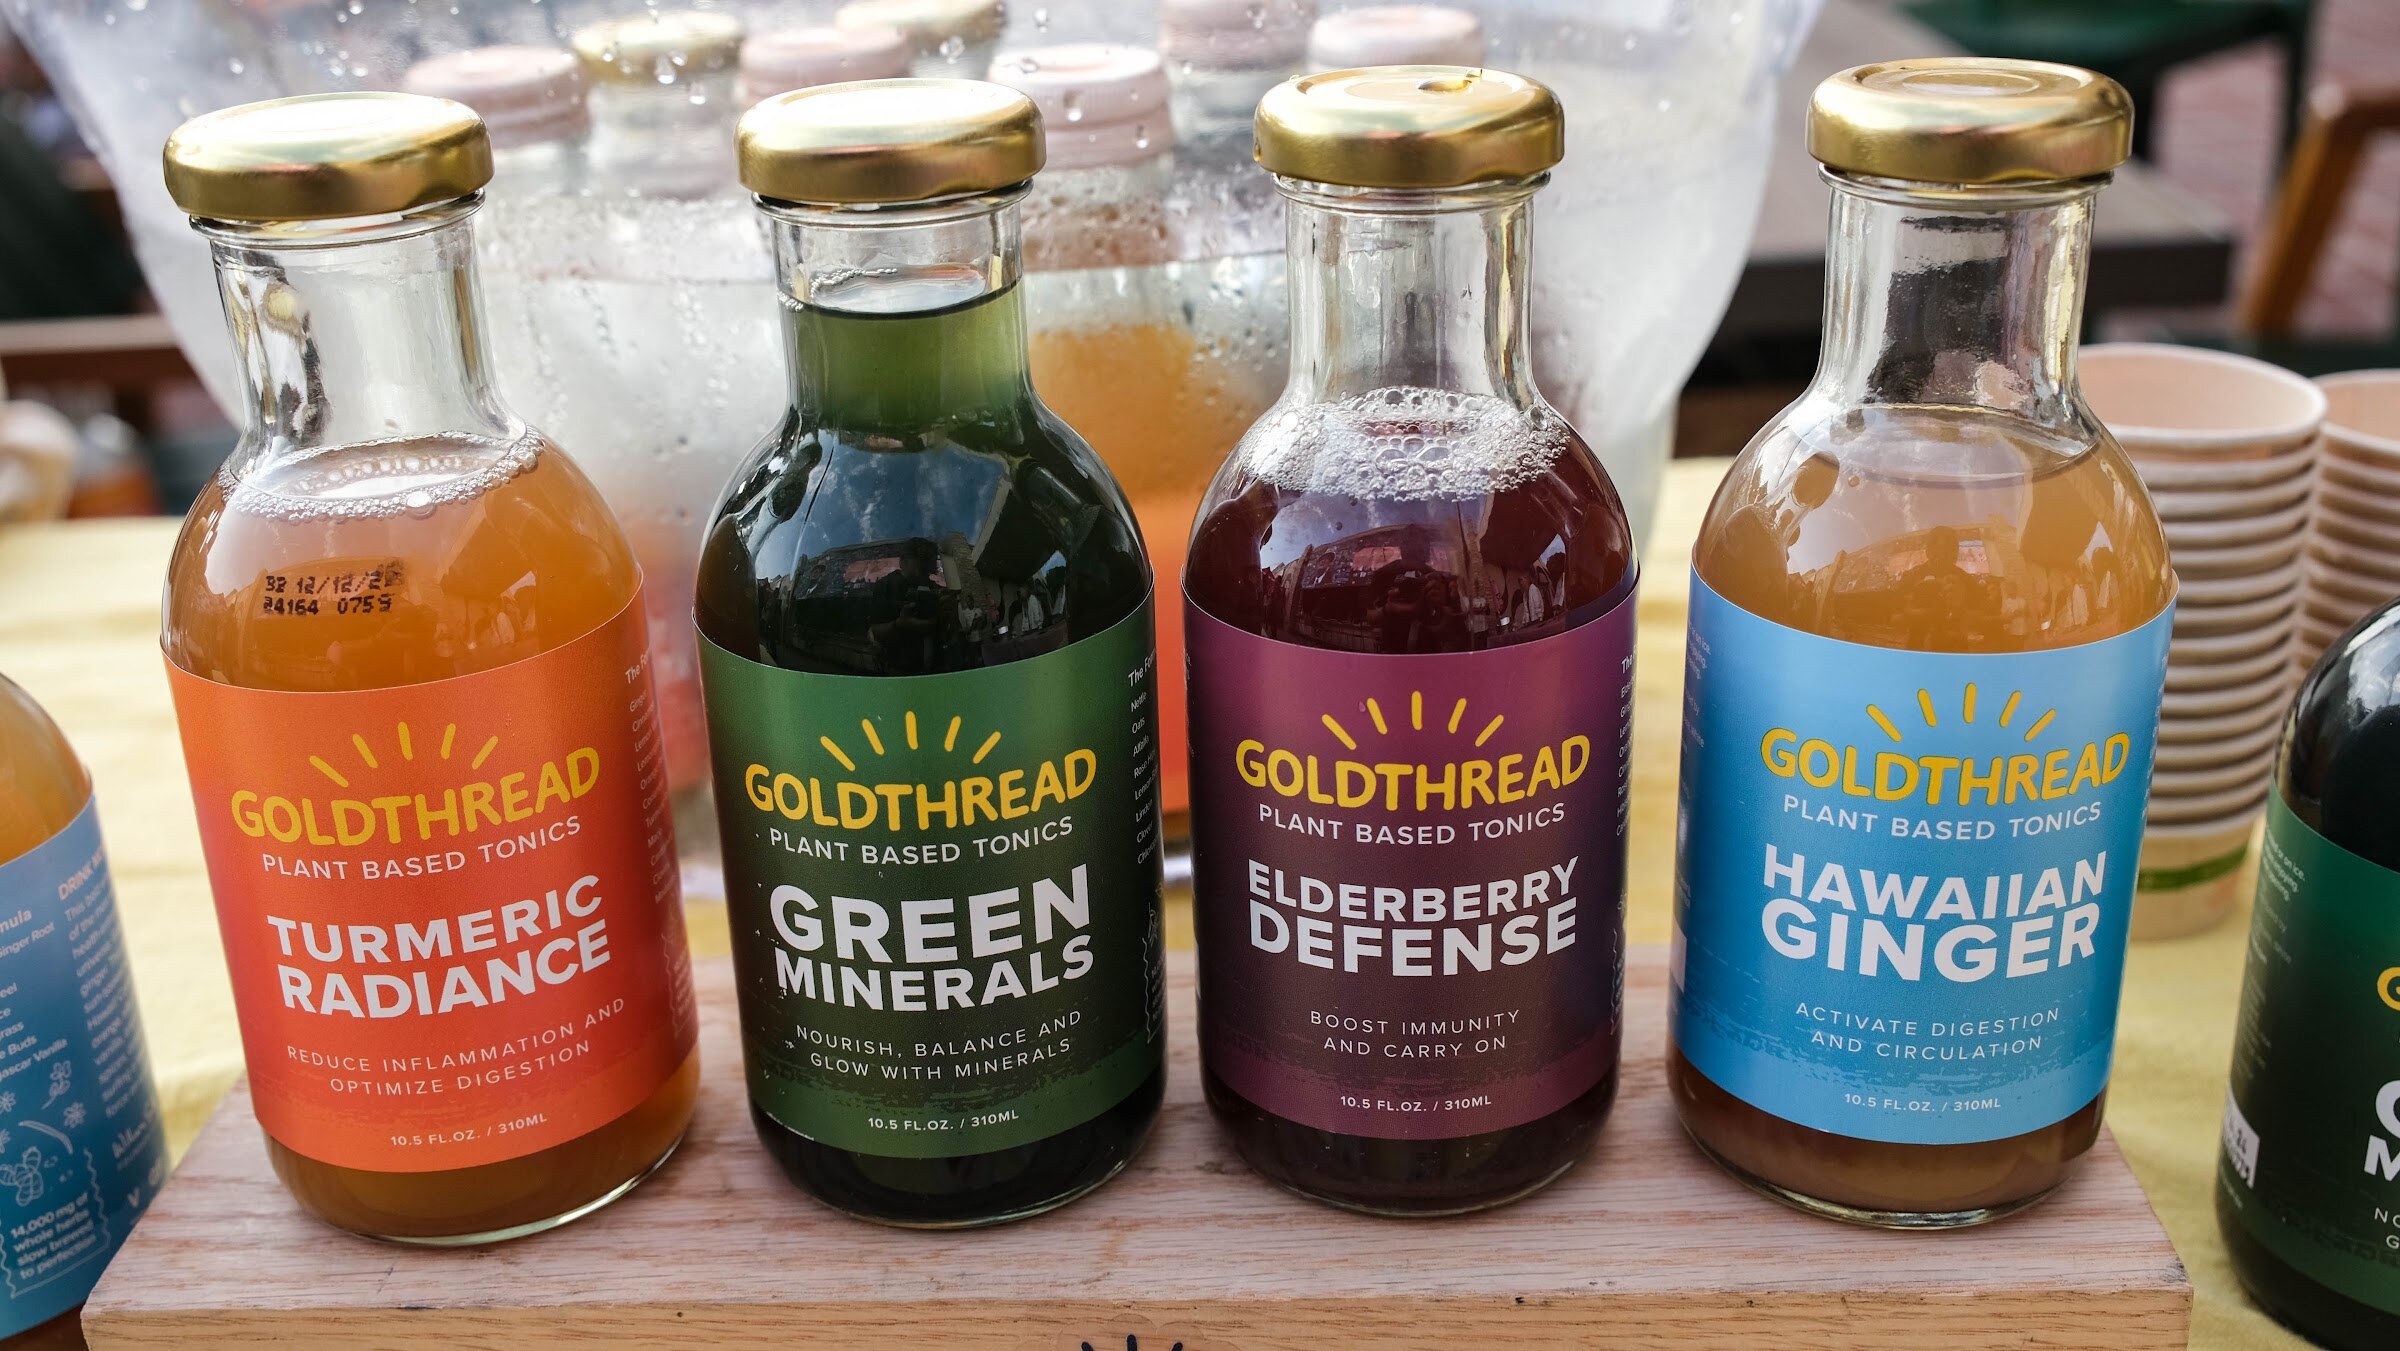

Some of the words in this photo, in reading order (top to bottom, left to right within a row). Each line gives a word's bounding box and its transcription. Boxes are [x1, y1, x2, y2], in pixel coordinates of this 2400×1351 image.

[625, 665, 641, 685] The
[1128, 664, 1143, 688] The
[1132, 716, 1146, 734] Oats
[1134, 759, 1148, 779] Rose
[1236, 735, 1590, 812] GOLDTHREAD
[1760, 727, 2131, 806] GOLDTHREAD
[232, 747, 600, 846] GOLDTHREAD
[745, 749, 1096, 832] GOLDTHREAD
[770, 828, 848, 861] PLANT
[862, 844, 960, 864] BASED
[973, 816, 1072, 857] TONICS
[1260, 804, 1342, 839] PLANT
[1356, 824, 1455, 844] BASED
[1468, 803, 1564, 841] TONICS
[1784, 794, 1878, 832] PLANT
[1892, 818, 1995, 840] BASED
[2009, 802, 2100, 837] TONICS
[263, 854, 347, 879] PLANT
[362, 852, 465, 879] BASED
[478, 816, 580, 862] TONICS
[1248, 856, 1578, 923] ELDERBERRY
[1764, 845, 2106, 920] HAWAIIAN
[267, 875, 602, 964] TURMERIC
[769, 864, 1090, 964] GREEN
[1249, 897, 1576, 977] DEFENSE
[1761, 898, 2100, 982] GINGER
[278, 918, 610, 1018] RADIANCE
[776, 934, 1093, 1011] MINERALS
[288, 1046, 370, 1071] REDUCE
[384, 1028, 574, 1072] INFLAMMATION
[585, 999, 623, 1028] AND
[797, 1025, 902, 1057] NOURISH,
[915, 1029, 1026, 1056] BALANCE
[1039, 1011, 1080, 1037] AND
[1311, 1011, 1388, 1033] BOOST
[1403, 1010, 1519, 1035] IMMUNITY
[1796, 1003, 1917, 1035] ACTIVATE
[1932, 1008, 2058, 1036] DIGESTION
[8, 1035, 38, 1055] Buds
[331, 1079, 443, 1095] OPTIMIZE
[458, 1040, 590, 1091] DIGESTION
[811, 1053, 868, 1076] GLOW
[881, 1066, 940, 1079] WITH
[956, 1039, 1070, 1077] MINERALS
[1324, 1037, 1370, 1054] AND
[1384, 1043, 1462, 1057] CARRY
[1476, 1036, 1505, 1052] ON
[1812, 1031, 1861, 1052] AND
[1877, 1036, 2040, 1060] CIRCULATION
[869, 1118, 897, 1129] 10.5
[904, 1118, 955, 1132] FL.OZ.
[972, 1110, 1018, 1126] 310ML
[1341, 1096, 1370, 1108] 10.5
[1377, 1099, 1426, 1112] FL.OZ.
[1445, 1096, 1491, 1110] 310ML
[1845, 1094, 1876, 1107] 10.5
[1884, 1098, 1936, 1113] FL.OZ.
[1954, 1098, 2000, 1111] 310ML
[391, 1136, 422, 1145] 10.5
[428, 1129, 481, 1144] FL.OZ.
[499, 1114, 546, 1133] 310ML
[14, 1228, 54, 1252] whole
[19, 1266, 36, 1281] to
